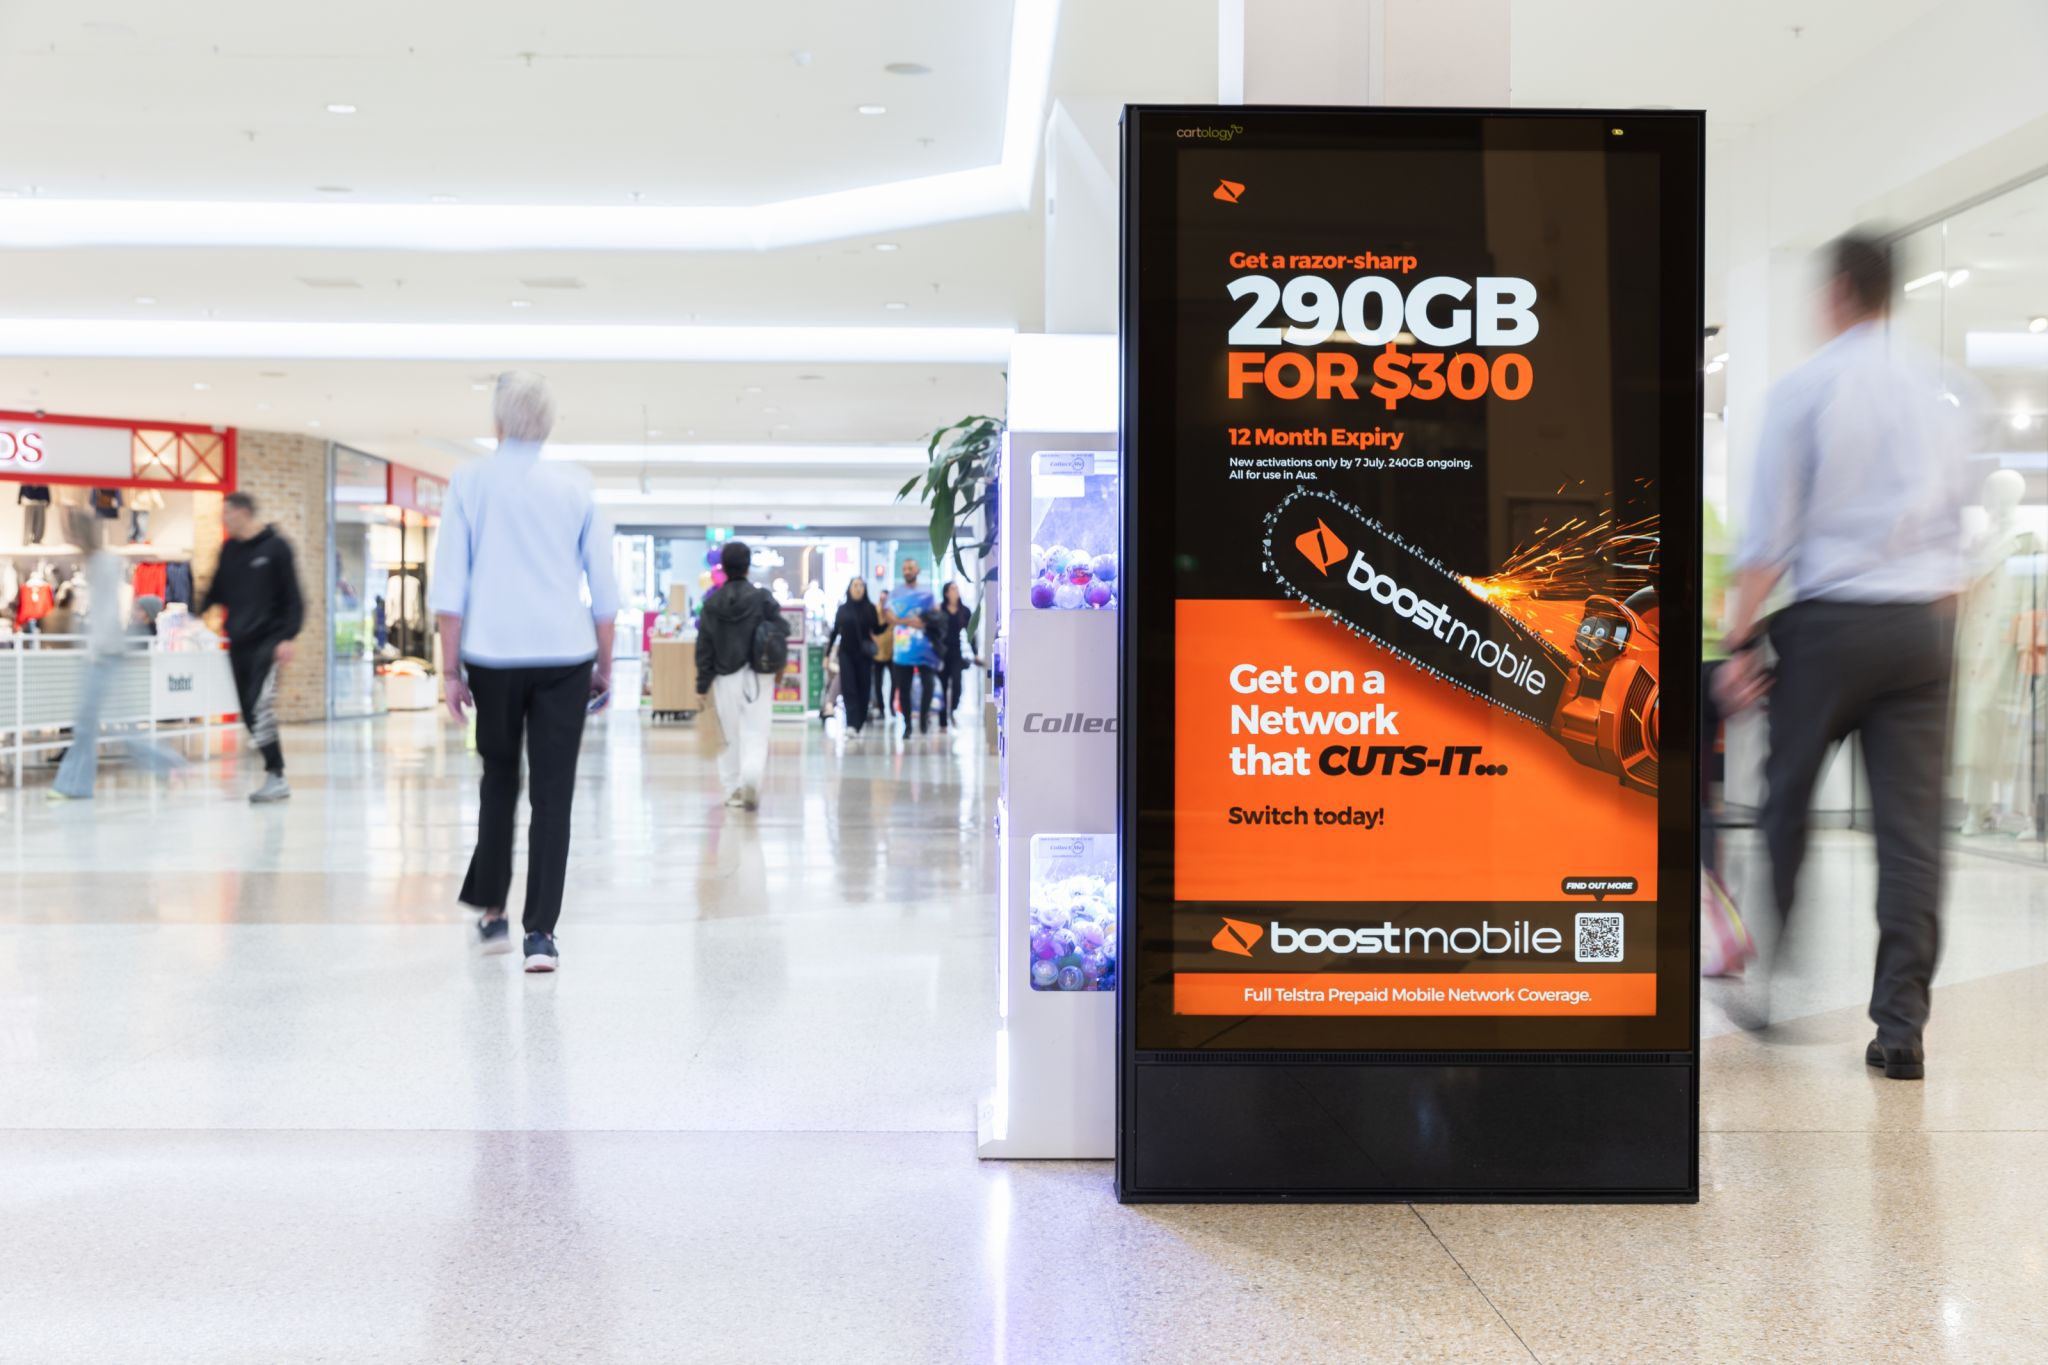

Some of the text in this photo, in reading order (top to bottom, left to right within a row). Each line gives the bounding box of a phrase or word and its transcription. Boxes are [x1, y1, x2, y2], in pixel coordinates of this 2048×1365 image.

[1176, 126, 1234, 141] cartology
[1229, 251, 1417, 274] Get a razor-sharp
[1226, 274, 1539, 346] 290GB
[1228, 342, 1533, 410] FOR $300
[1228, 426, 1404, 450] 12 Month Expiry
[1229, 457, 1473, 470] New activations only by 7 July. 240GB ongoing.
[1229, 469, 1318, 480] All for use in Aus.
[1345, 549, 1546, 696] boostmobile
[1229, 664, 1385, 694] Get on a
[1230, 704, 1399, 736] Network
[1229, 744, 1508, 776] that CUTS-IT...
[1228, 806, 1384, 829] Switch today!
[1271, 920, 1562, 954] boostmobile
[1244, 988, 1592, 1004] Full Telstra Prepaid Mobile Network Coverage.
